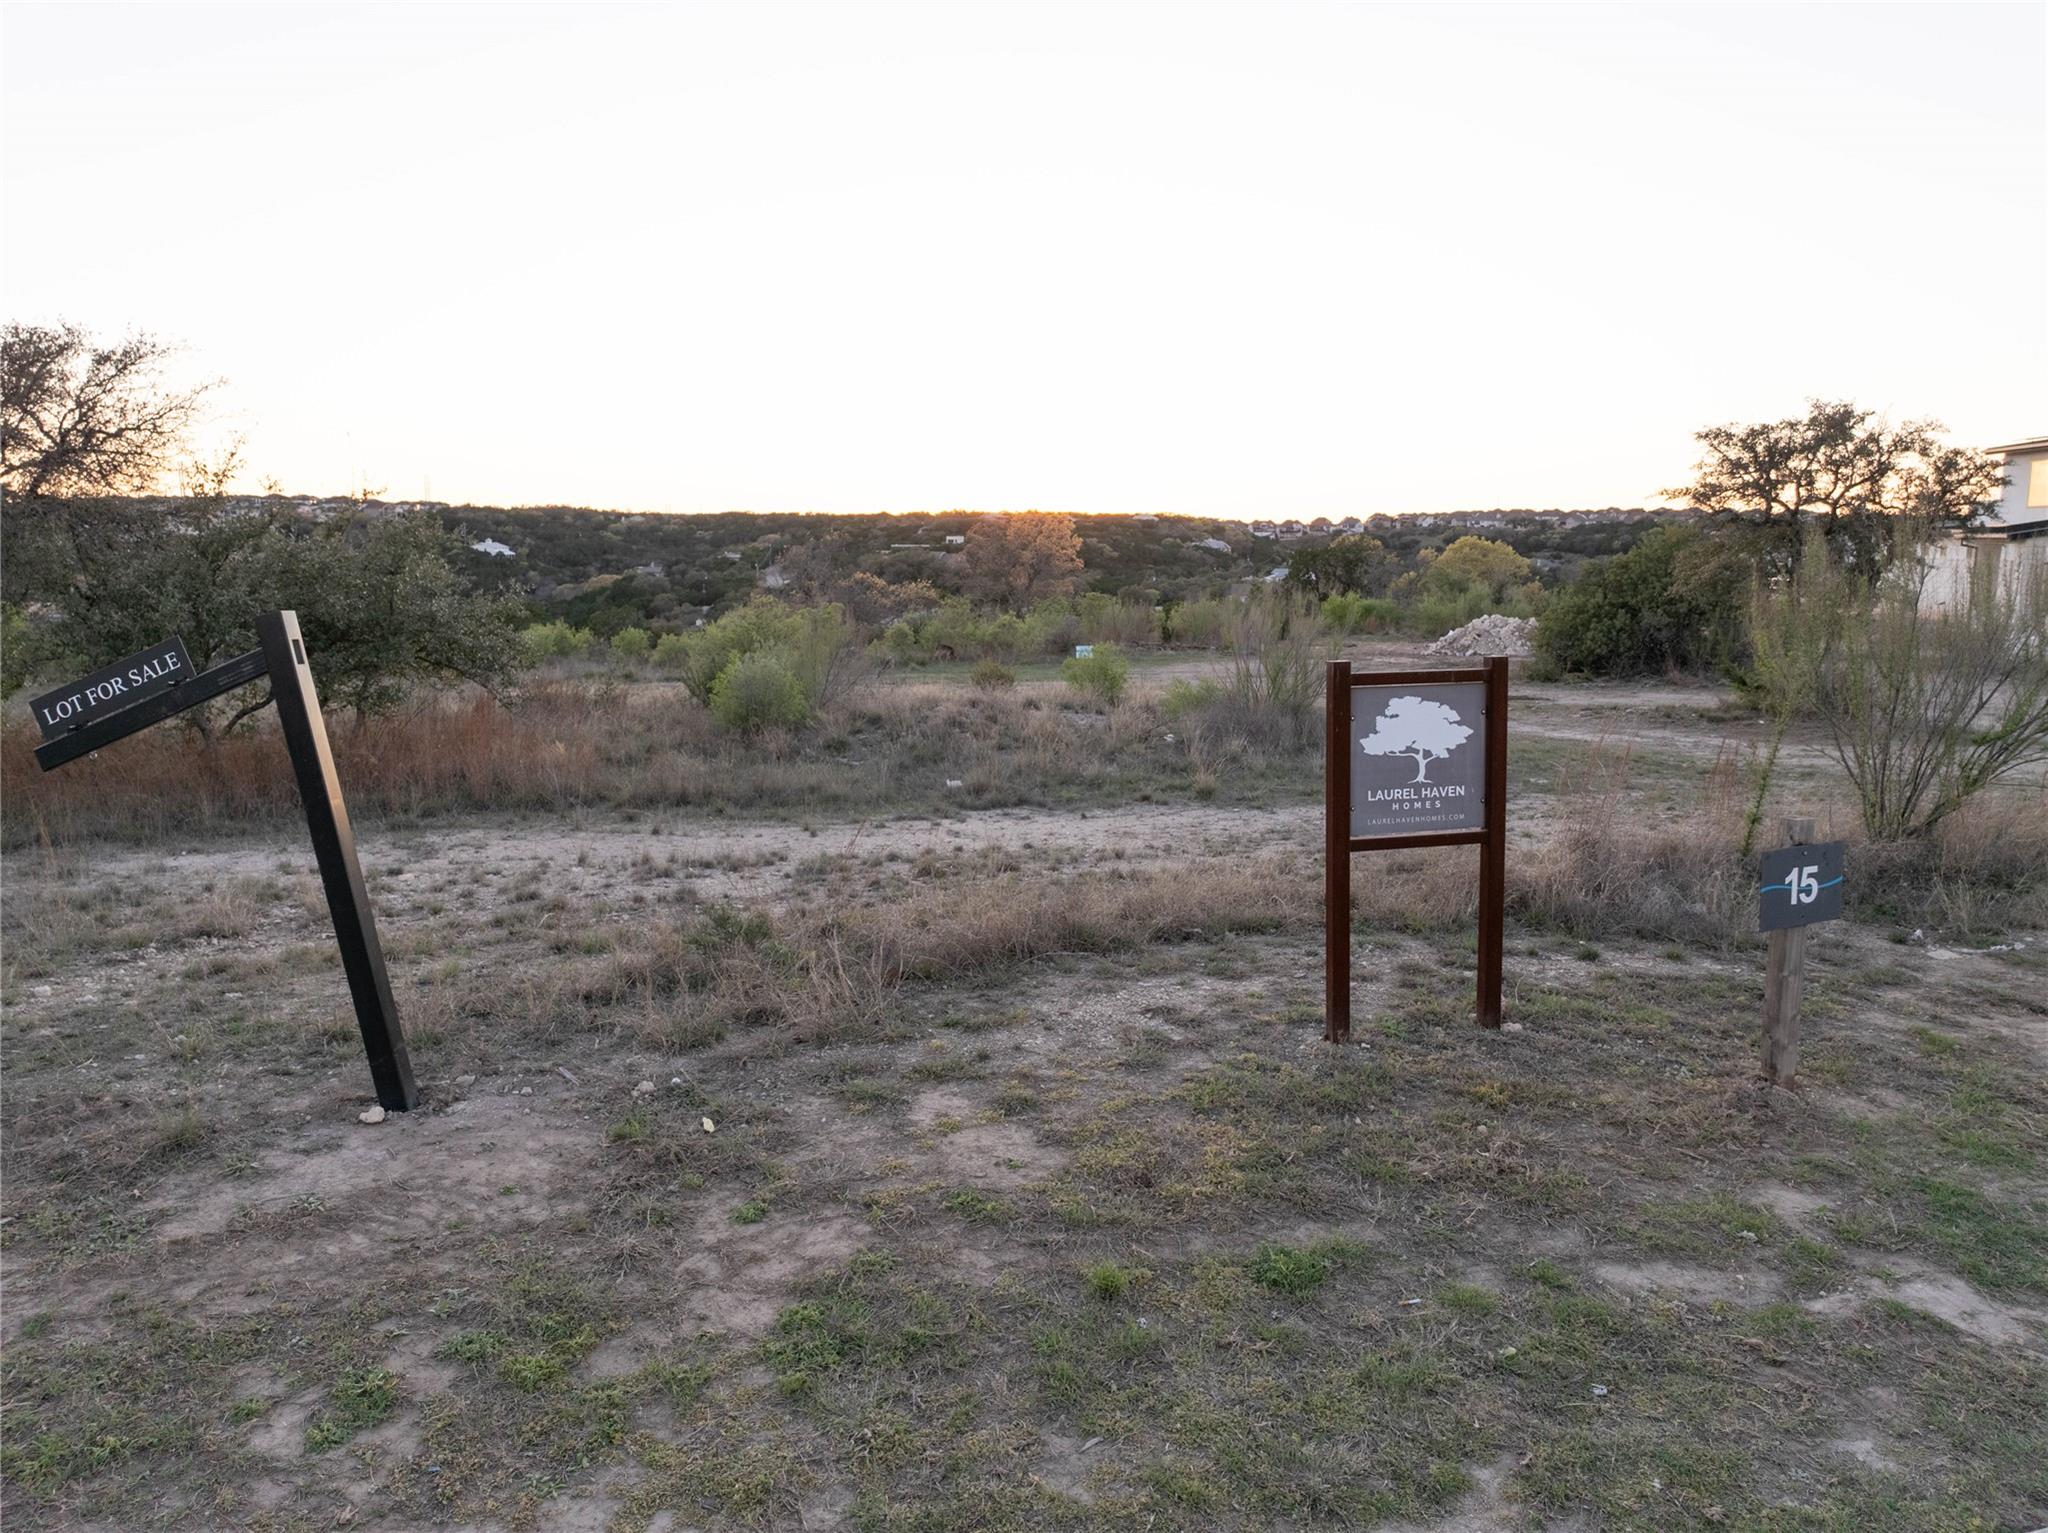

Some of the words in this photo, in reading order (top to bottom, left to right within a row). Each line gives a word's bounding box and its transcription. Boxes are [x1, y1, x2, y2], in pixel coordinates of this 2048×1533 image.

[42, 694, 83, 725] LOT
[85, 677, 129, 707] FOR
[128, 652, 182, 687] SALE
[1368, 788, 1418, 801] LAUREL
[1421, 785, 1465, 798] HAVEN
[1392, 800, 1441, 811] HOMES
[1368, 813, 1465, 825] LAURELHAVENHOMES.COM
[1784, 865, 1819, 905] 15
